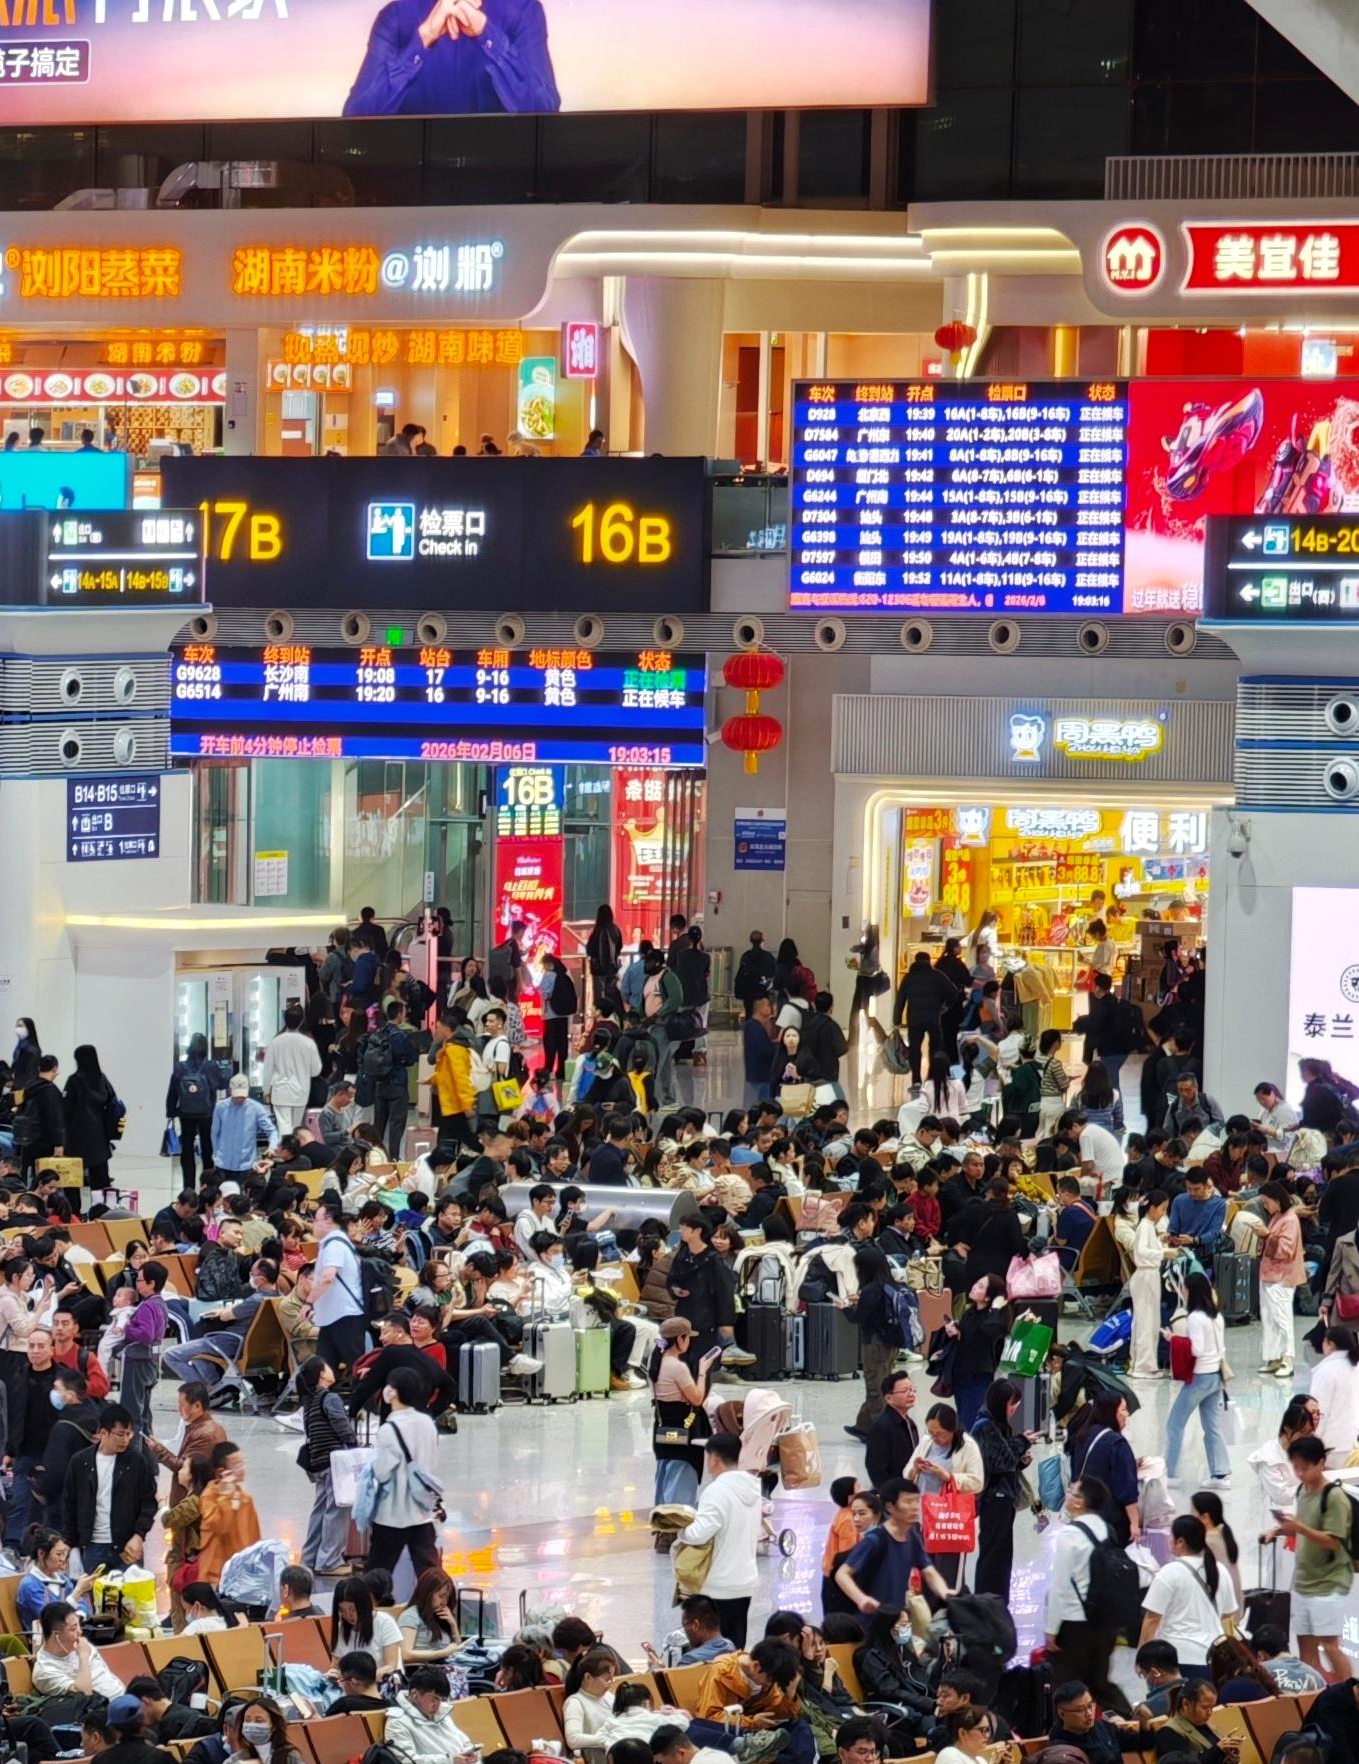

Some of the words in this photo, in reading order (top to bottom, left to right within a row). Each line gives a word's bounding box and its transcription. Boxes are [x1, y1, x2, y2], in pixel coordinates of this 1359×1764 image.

[1215, 232, 1341, 281] 美宜佳
[21, 247, 180, 297] 浏阳蒸菜
[419, 508, 486, 537] 检票口
[570, 502, 673, 565] 16B
[418, 539, 460, 556] Check
[465, 539, 478, 556] in
[184, 646, 213, 664] 车次
[263, 646, 309, 665] 终到站
[360, 648, 391, 666] 开点
[420, 649, 450, 667] 站台
[477, 649, 508, 667] 车厢
[529, 650, 592, 668] 地标颜色
[639, 652, 671, 671] 状态
[176, 666, 220, 681] G9628
[263, 665, 309, 683] 长沙南
[356, 668, 395, 684] 19:08
[426, 669, 444, 684] 17
[476, 669, 509, 685] 9-16
[544, 669, 576, 688] 黄色
[176, 684, 221, 700] G6514
[263, 684, 309, 702] 广州南
[356, 687, 395, 703] 19:20
[426, 688, 444, 704] 16
[476, 688, 509, 704] 9-16
[544, 688, 576, 707] 黄色
[622, 690, 685, 709] 正在候车
[1056, 720, 1159, 747] 周黑鸭
[421, 741, 536, 761] 2026年02月06日
[608, 746, 672, 764] 19:03:15
[503, 776, 555, 806] 16B
[1121, 810, 1207, 853] 便利
[1303, 1012, 1359, 1040] 泰兰
